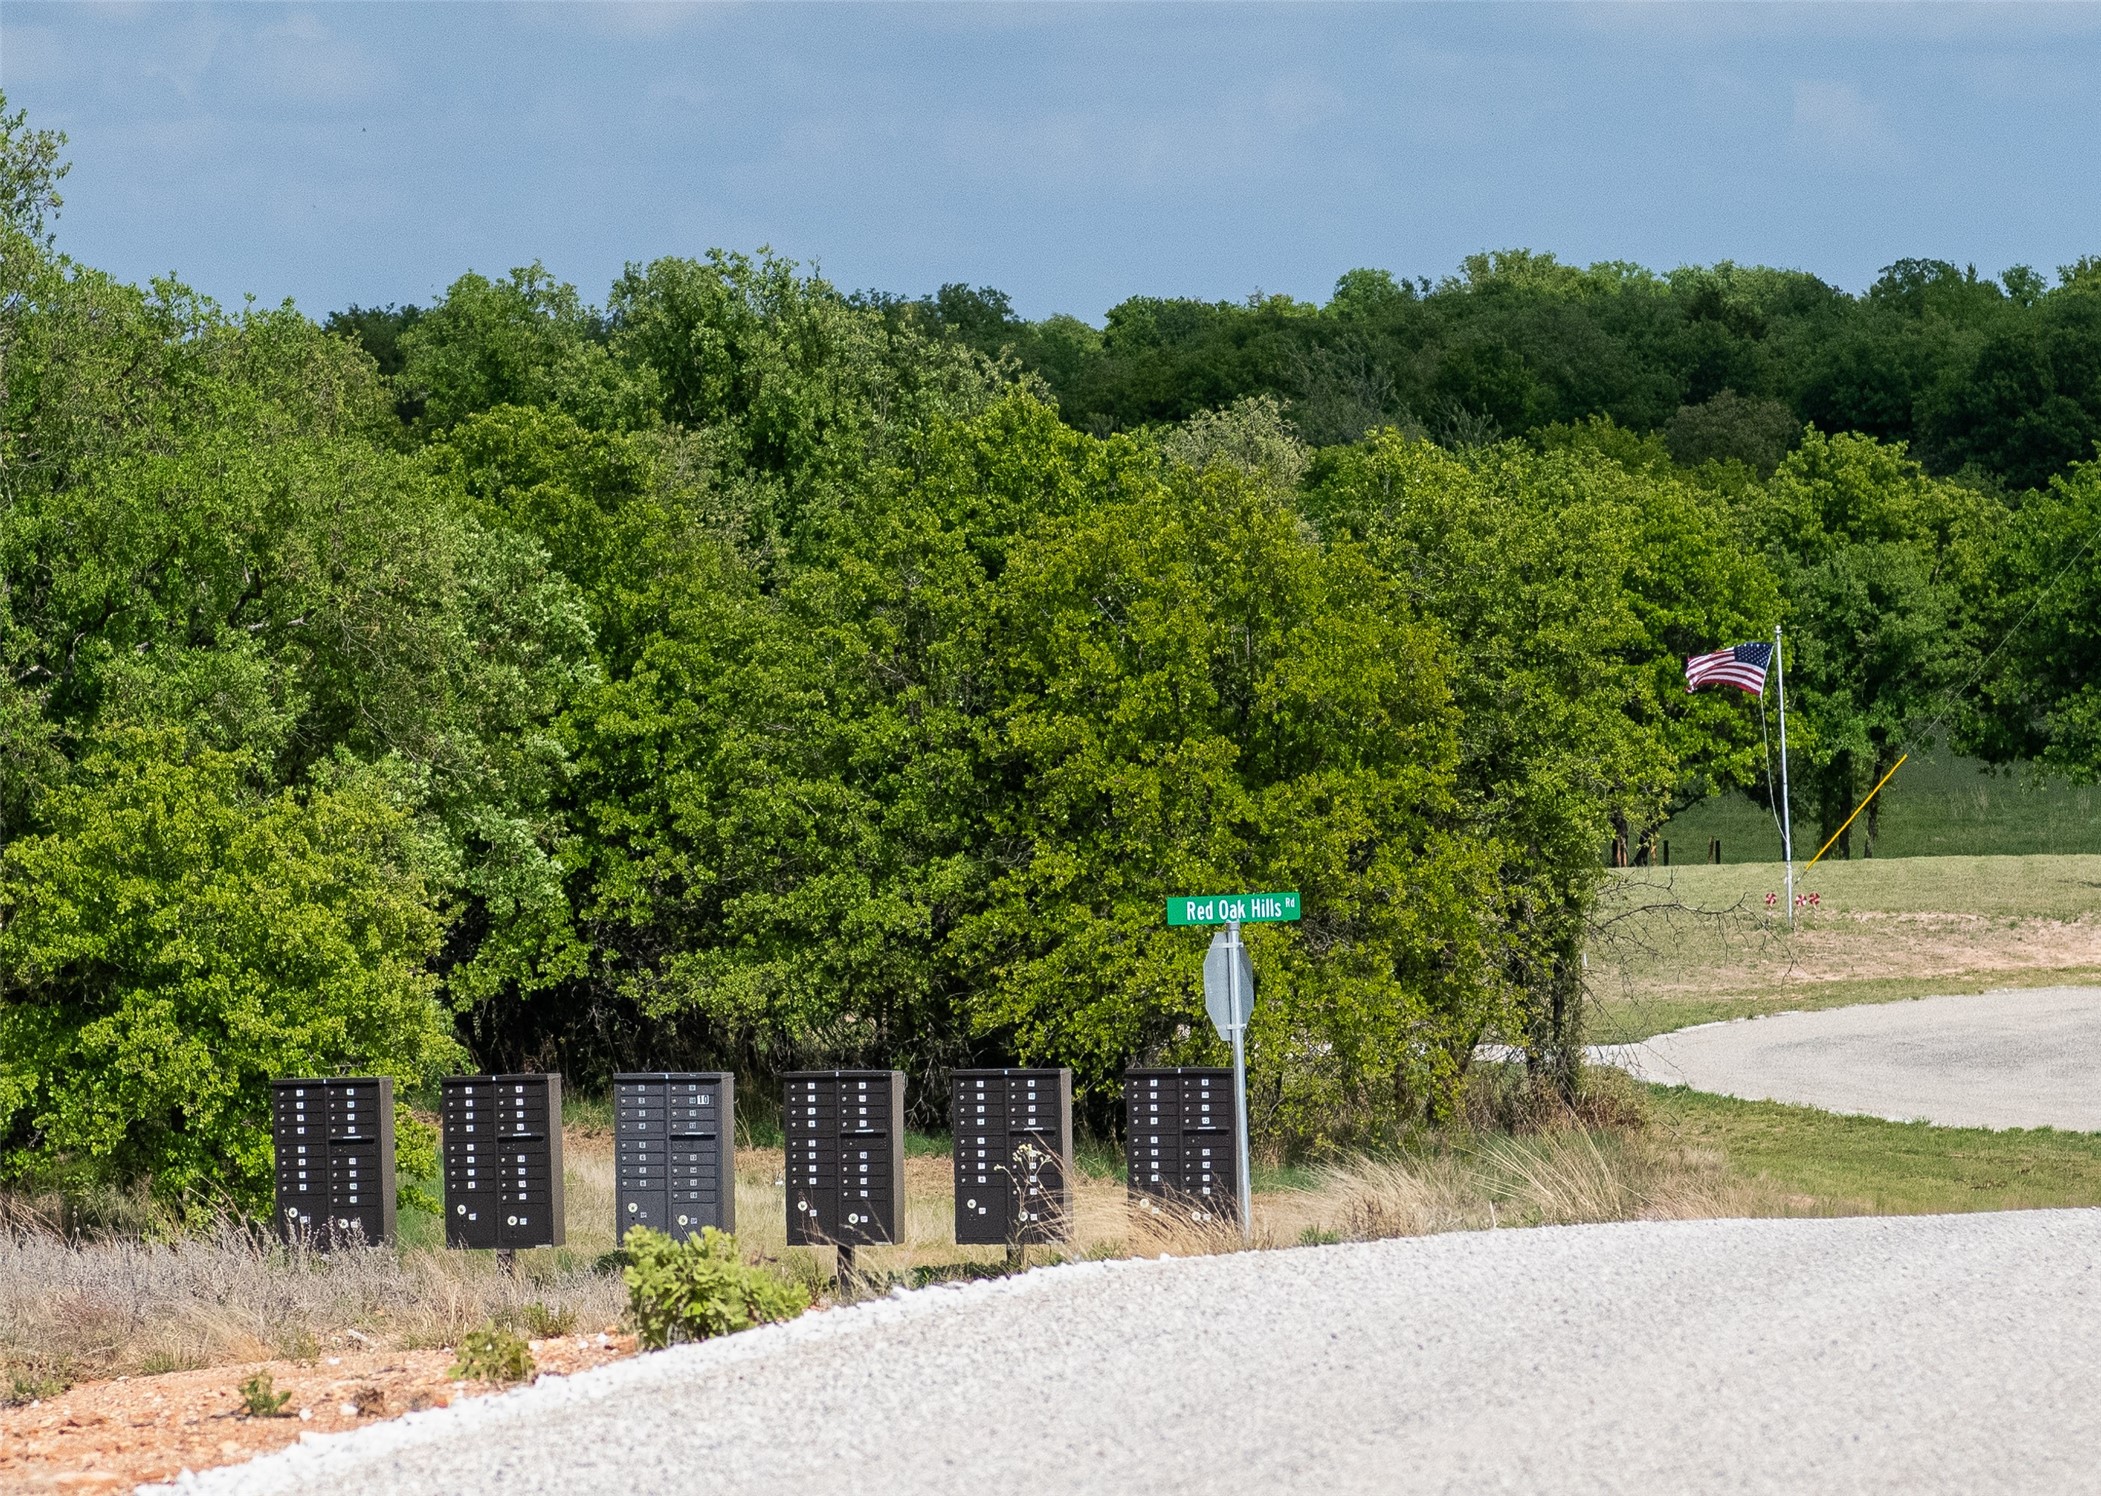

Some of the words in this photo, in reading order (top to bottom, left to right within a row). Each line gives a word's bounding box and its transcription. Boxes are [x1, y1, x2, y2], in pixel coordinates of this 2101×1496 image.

[1186, 901, 1213, 921] Red
[1218, 899, 1246, 920] Oak
[1251, 898, 1282, 918] Hills
[1285, 897, 1295, 908] Rd
[698, 1096, 709, 1104] 10
